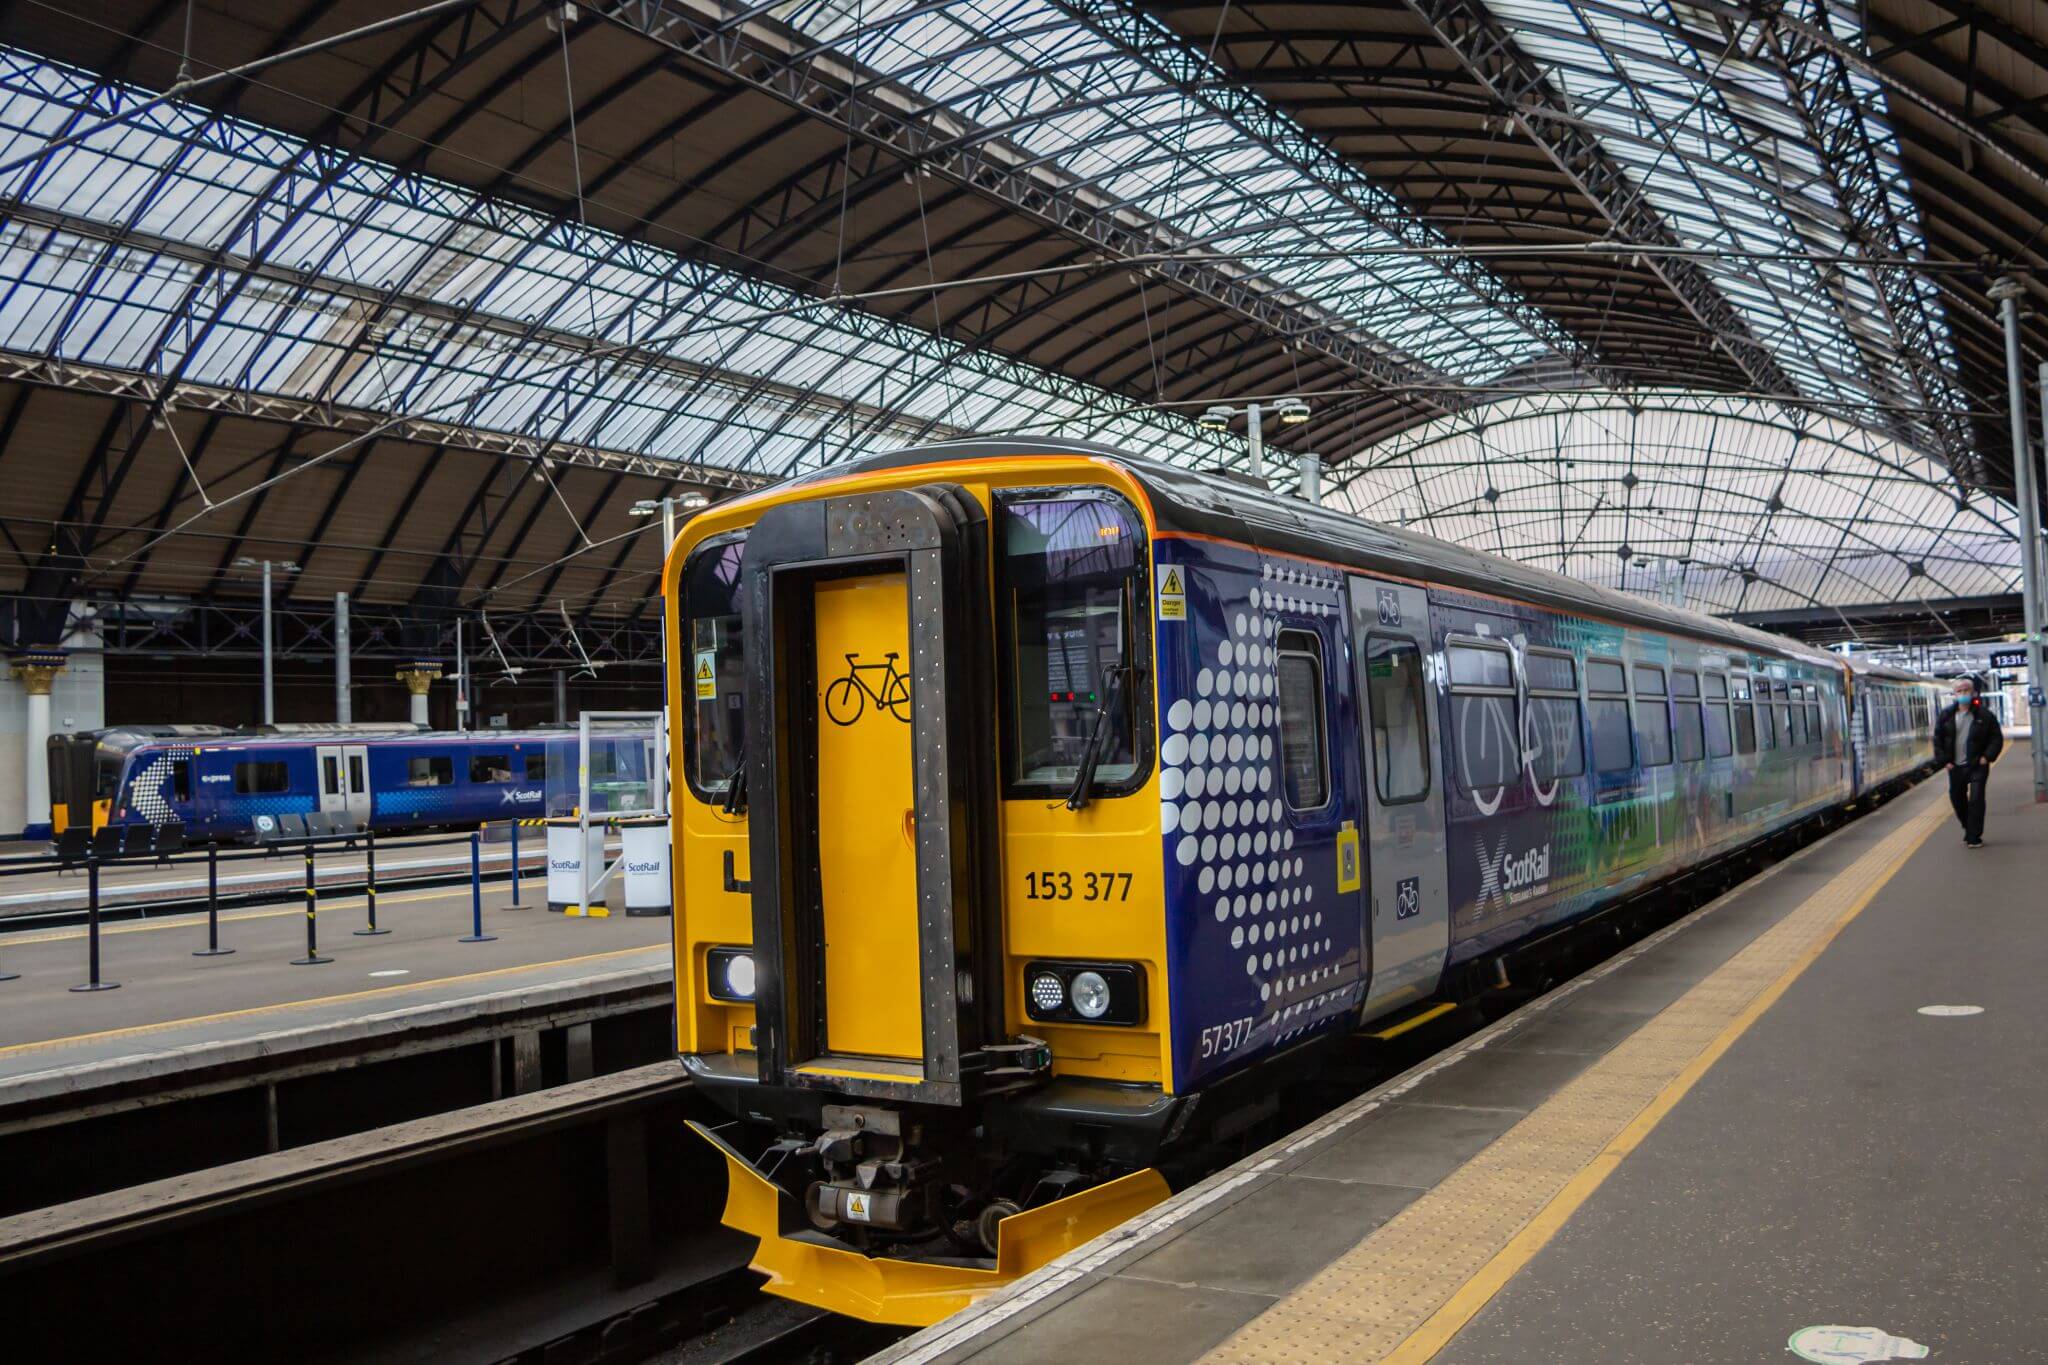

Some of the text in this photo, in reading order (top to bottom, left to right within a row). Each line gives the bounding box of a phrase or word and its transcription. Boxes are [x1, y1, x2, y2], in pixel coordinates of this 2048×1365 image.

[515, 790, 542, 800] ScotRail
[551, 859, 580, 870] ScotRail
[628, 861, 659, 872] ScotRail
[1504, 842, 1549, 890] ScotRail
[1025, 871, 1133, 902] 153 377
[1202, 1016, 1253, 1058] 57377
